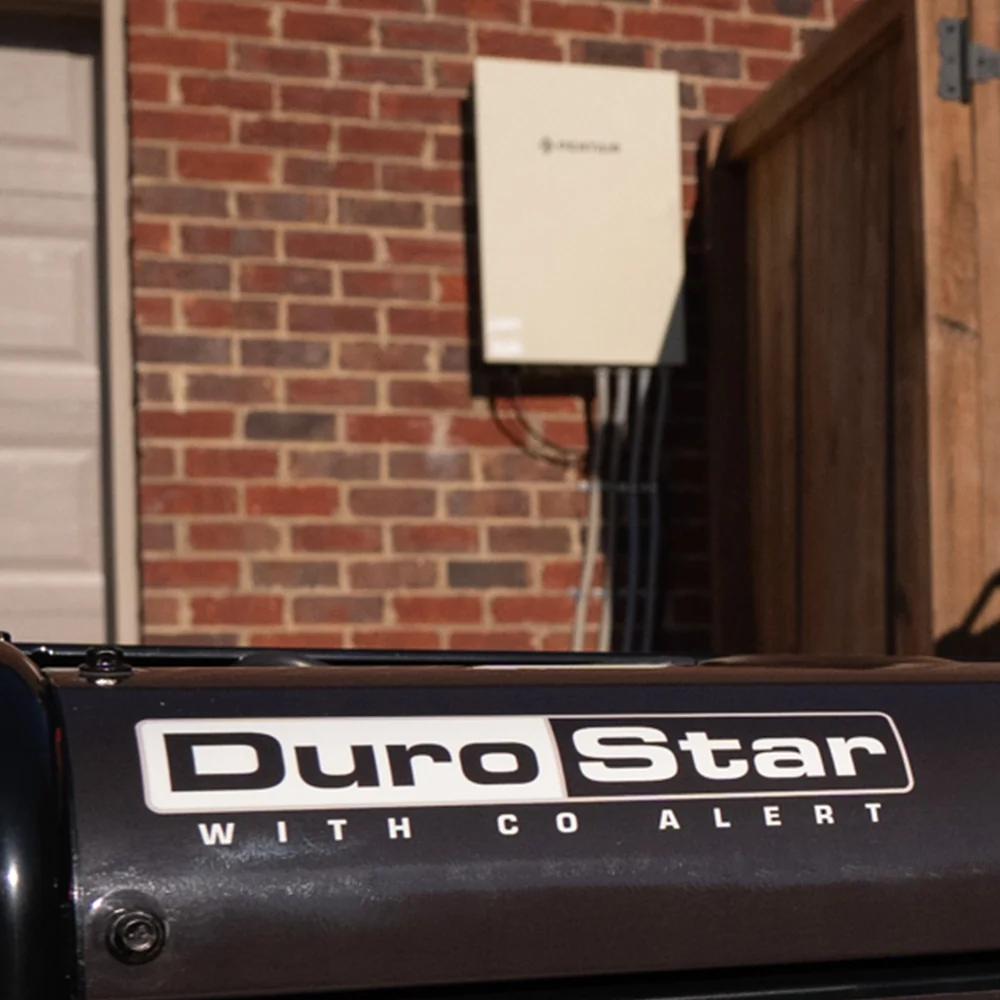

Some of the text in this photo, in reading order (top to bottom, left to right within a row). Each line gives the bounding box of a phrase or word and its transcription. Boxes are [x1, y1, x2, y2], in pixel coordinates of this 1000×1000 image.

[198, 803, 882, 846] WITH CO ALERT
